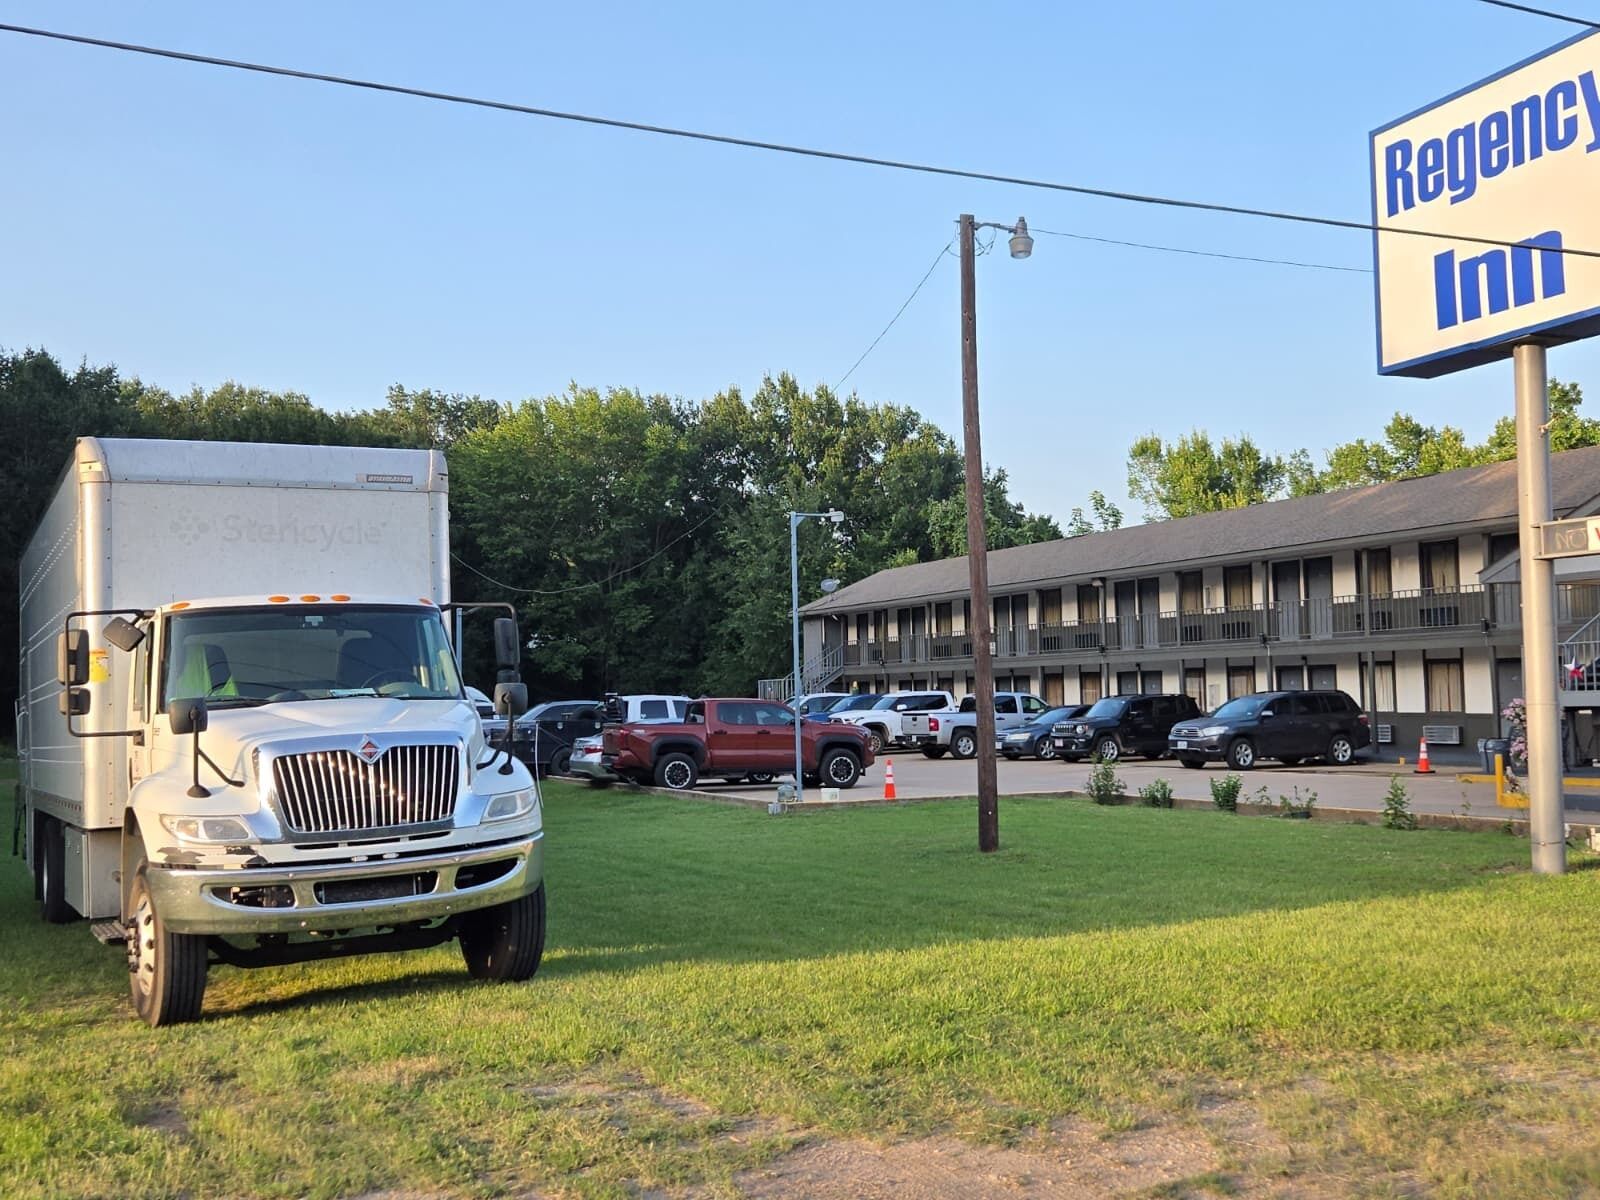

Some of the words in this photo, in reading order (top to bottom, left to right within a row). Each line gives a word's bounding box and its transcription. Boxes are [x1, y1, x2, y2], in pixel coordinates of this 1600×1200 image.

[1385, 71, 1600, 217] Regency
[1434, 230, 1565, 330] Inn
[1555, 528, 1587, 551] NO
